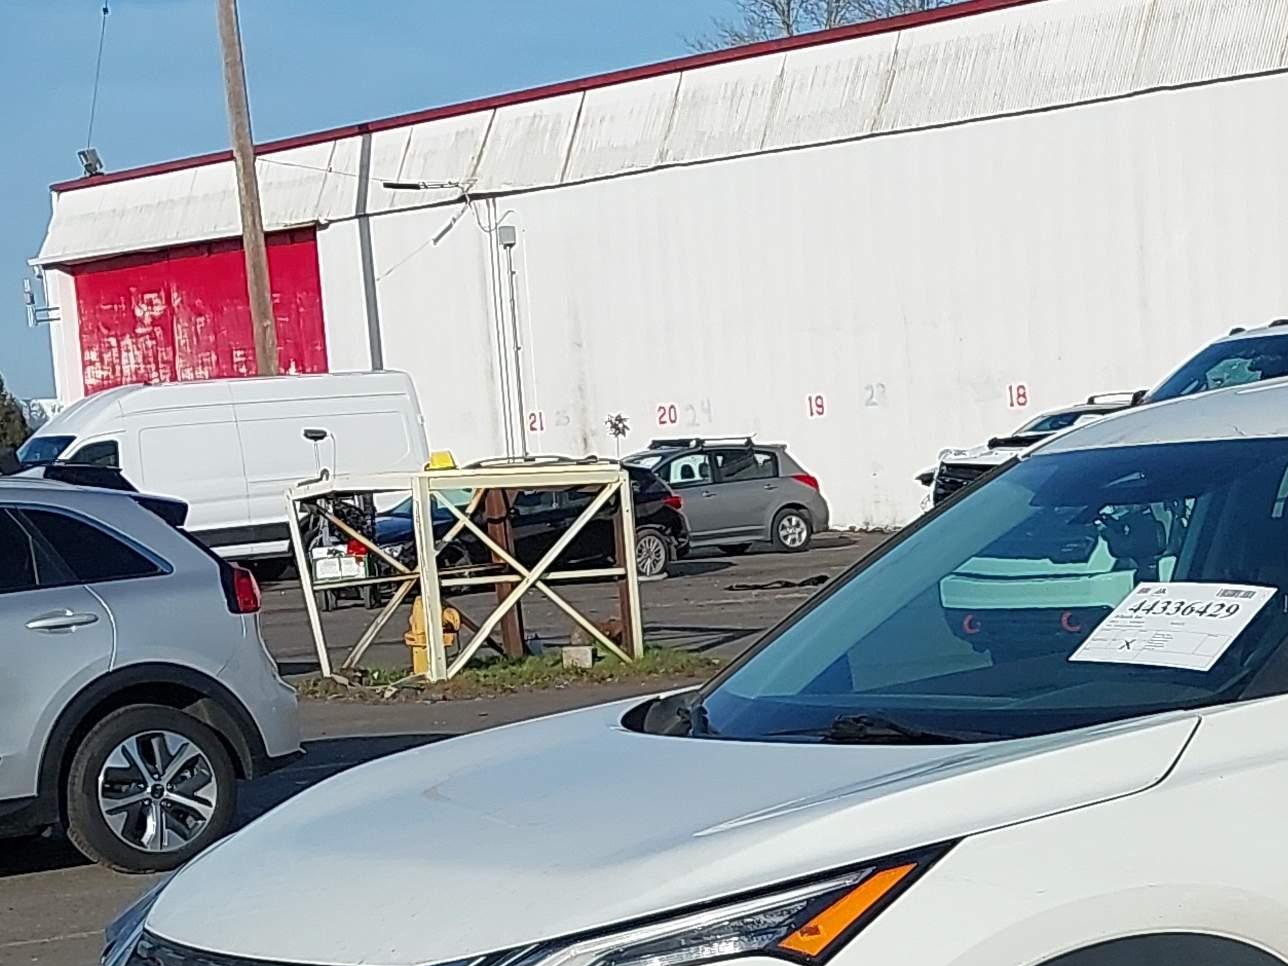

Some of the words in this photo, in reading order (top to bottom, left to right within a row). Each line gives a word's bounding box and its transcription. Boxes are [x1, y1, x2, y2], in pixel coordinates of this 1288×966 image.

[808, 394, 825, 417] 19
[1008, 384, 1028, 407] 18
[528, 411, 545, 432] 21
[656, 403, 678, 425] 20
[1128, 598, 1241, 620] 44336429
